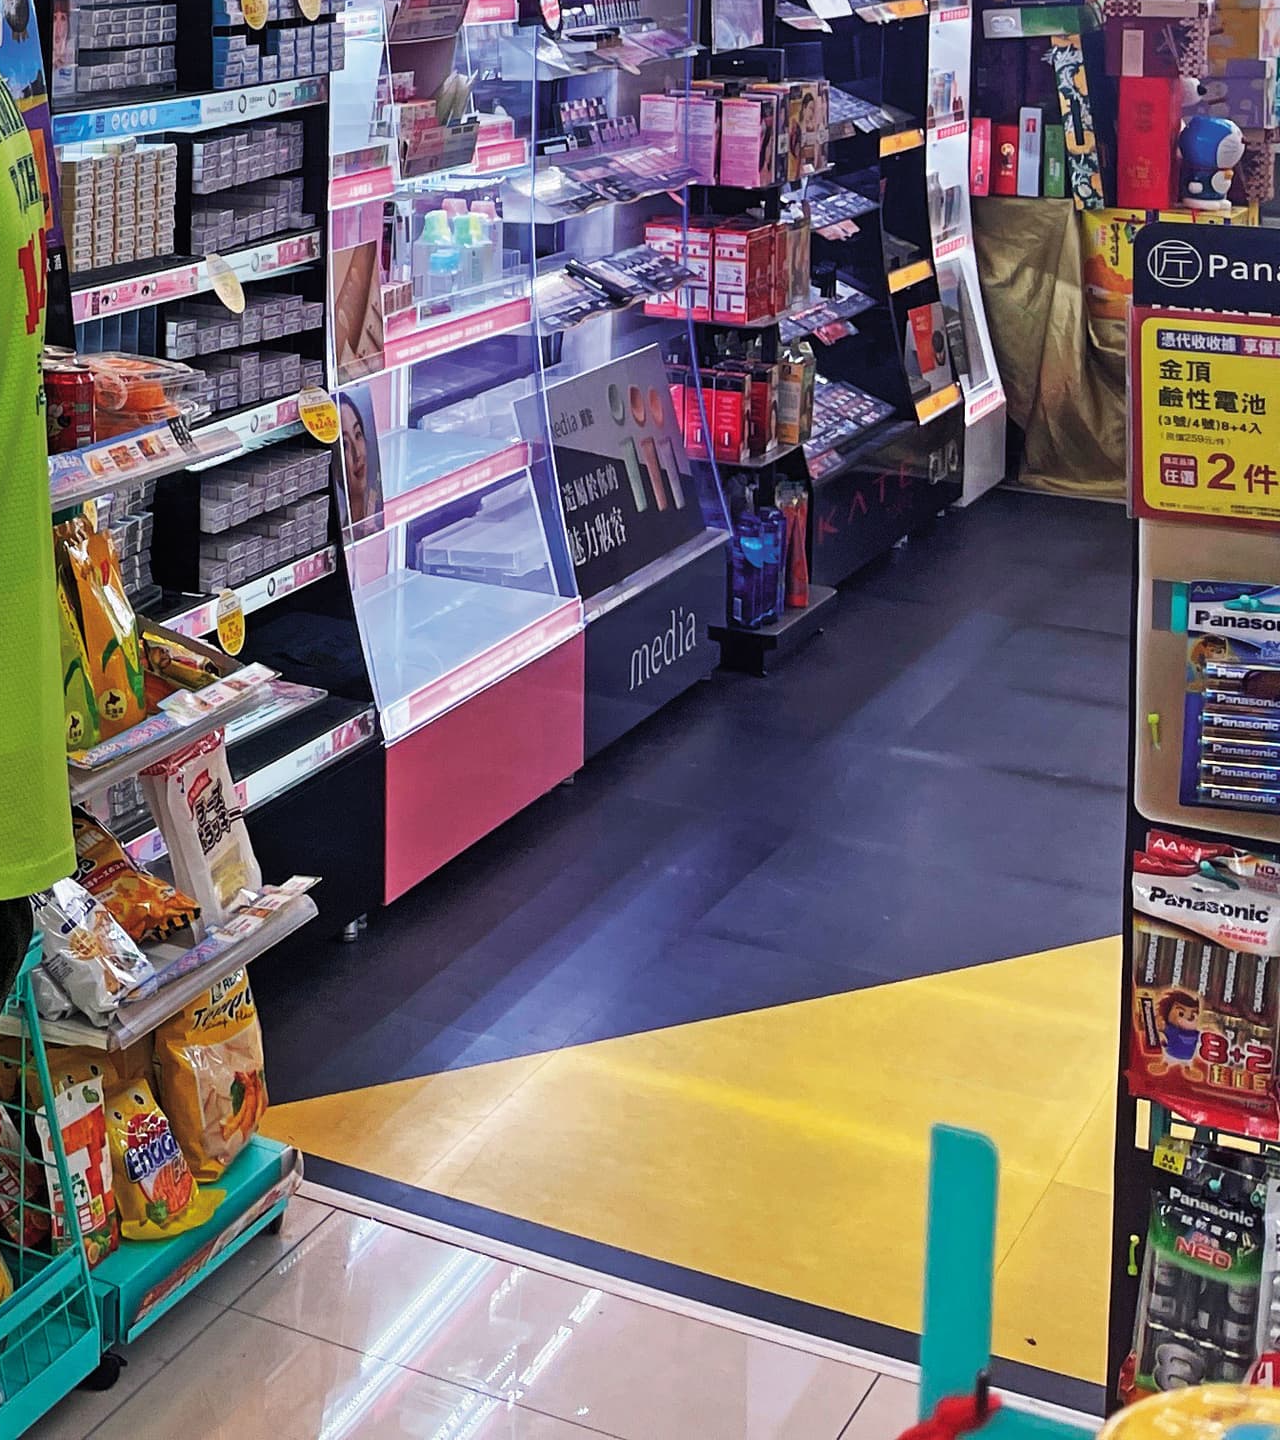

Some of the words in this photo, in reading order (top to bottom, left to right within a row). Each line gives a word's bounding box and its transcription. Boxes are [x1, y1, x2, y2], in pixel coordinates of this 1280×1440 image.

[1161, 331, 1237, 353] 憑代收收據
[1159, 359, 1212, 384] 金頂
[1158, 386, 1268, 416] 鹼性電池
[1193, 585, 1215, 595] AA
[629, 606, 697, 692] media
[1213, 715, 1279, 731] Panasonic
[1213, 743, 1278, 759] Panasonic
[1211, 765, 1277, 781] Panasonic
[1211, 788, 1277, 805] Panasonic
[1153, 837, 1179, 852] AA
[1149, 886, 1270, 924] Panasonic
[1199, 1030, 1272, 1074] 8+2
[1170, 1186, 1255, 1228] Panasonic
[1175, 1235, 1233, 1271] NEO
